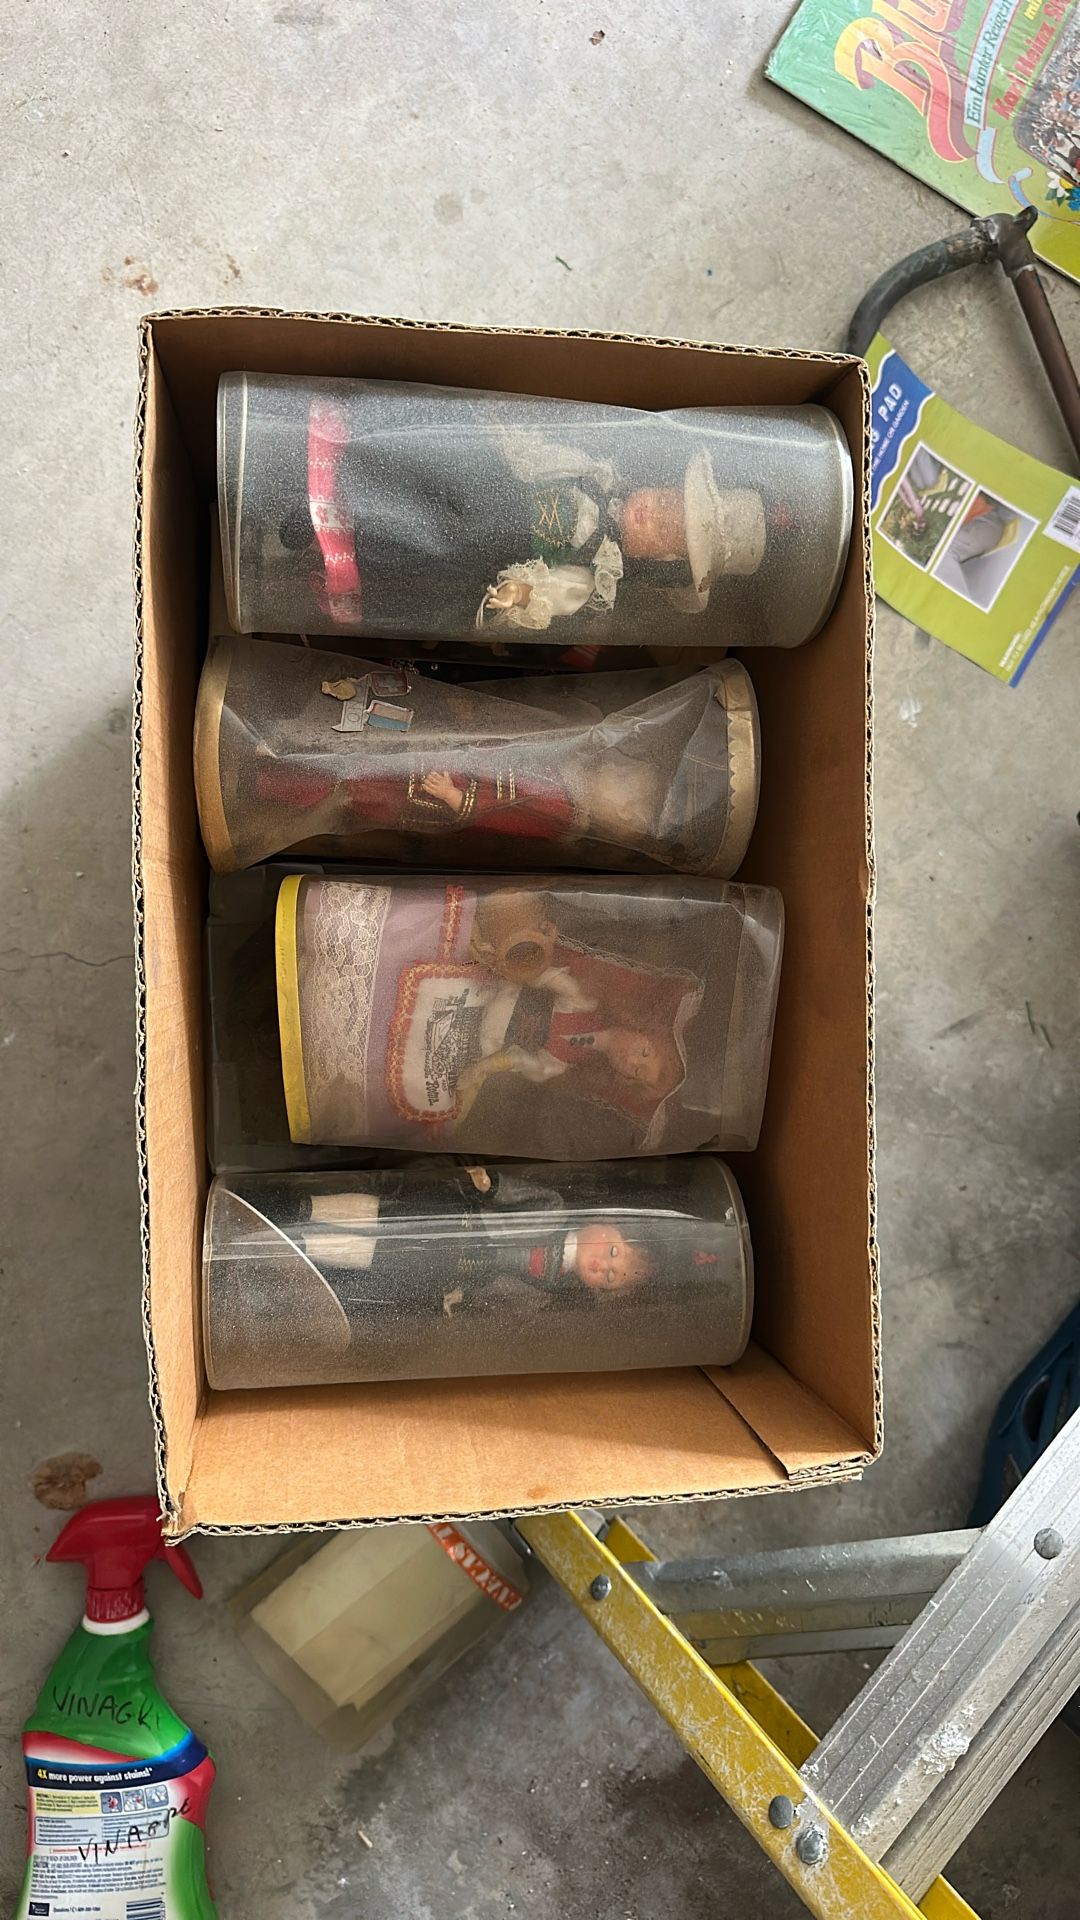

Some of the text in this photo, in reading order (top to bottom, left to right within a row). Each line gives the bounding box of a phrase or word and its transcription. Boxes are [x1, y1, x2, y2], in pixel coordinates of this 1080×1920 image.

[969, 50, 993, 96] bunter
[992, 71, 1025, 120] Karl
[1014, 22, 1056, 78] Heinz
[966, 97, 984, 125] Ein
[878, 383, 902, 422] PAD
[37, 1769, 47, 1780] 4X
[48, 1772, 68, 1781] more
[69, 1774, 93, 1785] power
[94, 1772, 123, 1785] against
